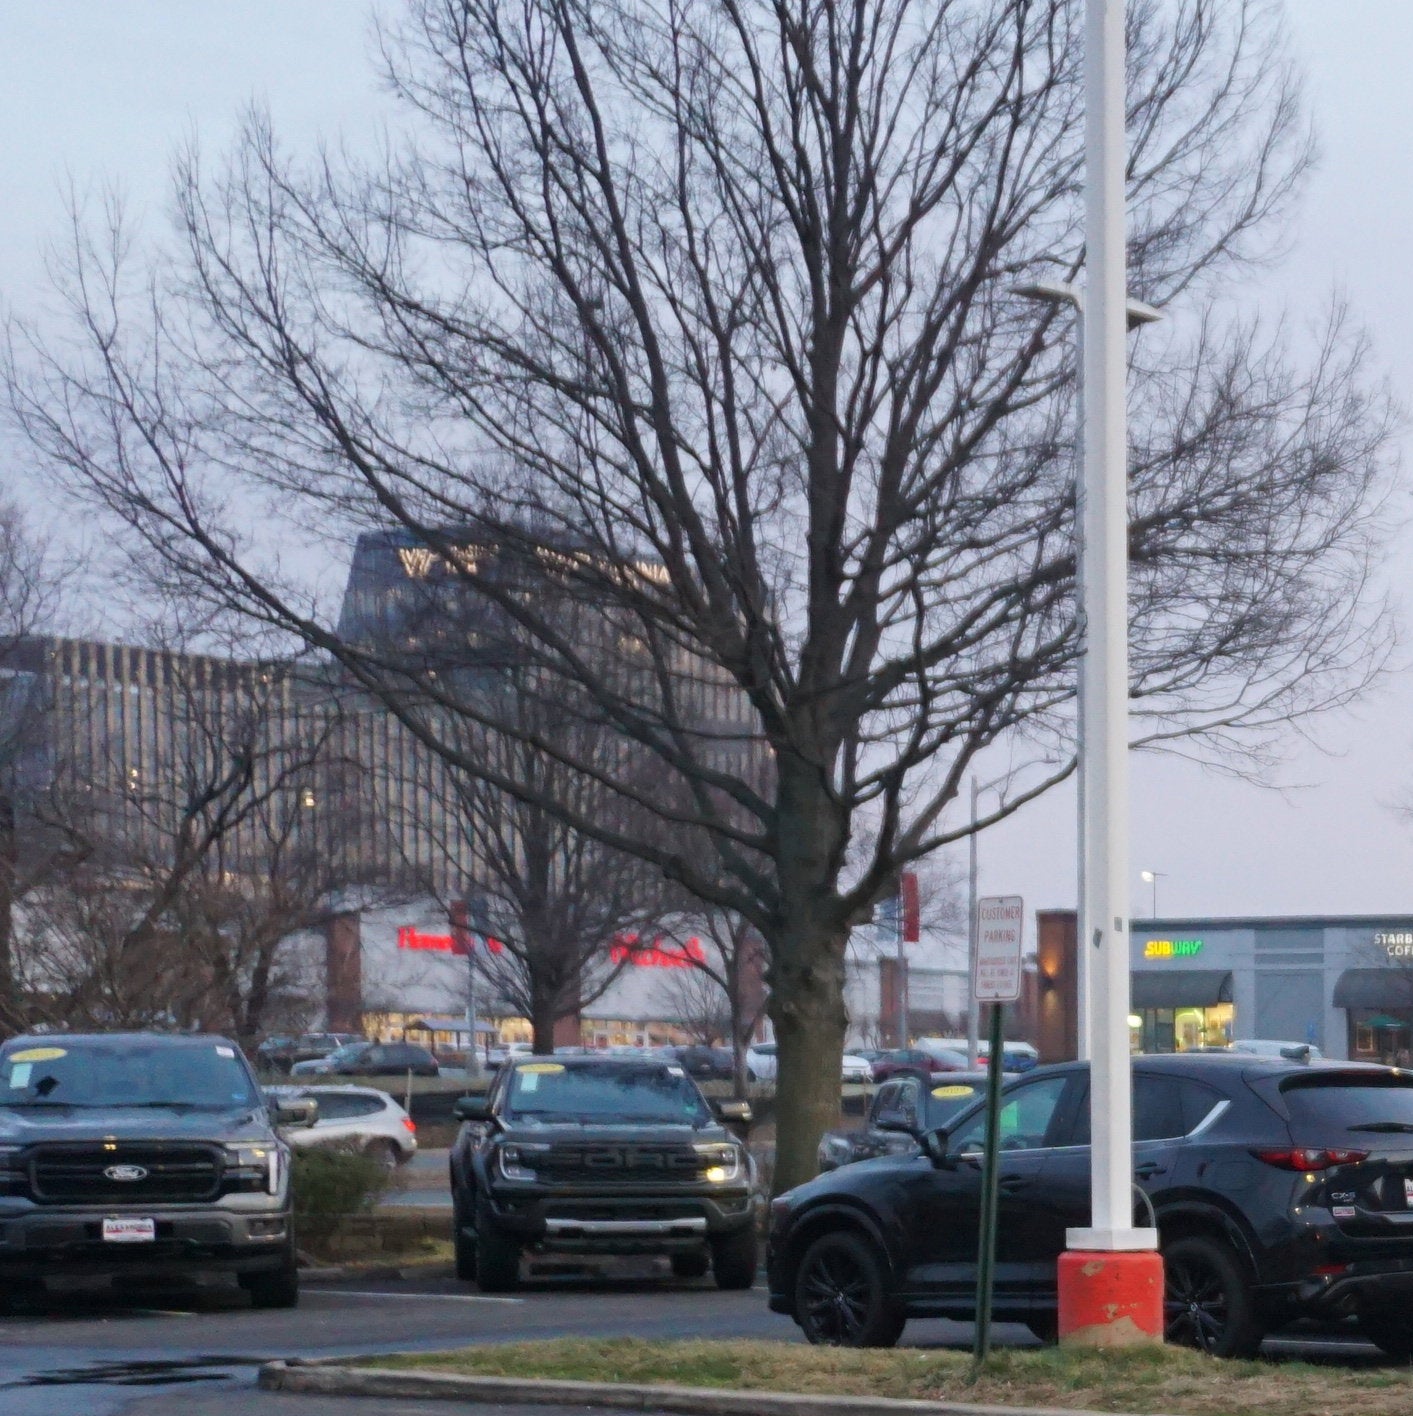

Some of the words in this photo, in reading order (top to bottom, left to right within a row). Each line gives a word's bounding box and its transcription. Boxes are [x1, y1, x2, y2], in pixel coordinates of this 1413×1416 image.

[981, 906, 1020, 920] CUSTOMER
[984, 930, 1016, 942] PARKING
[1145, 940, 1202, 957] SUBWAY
